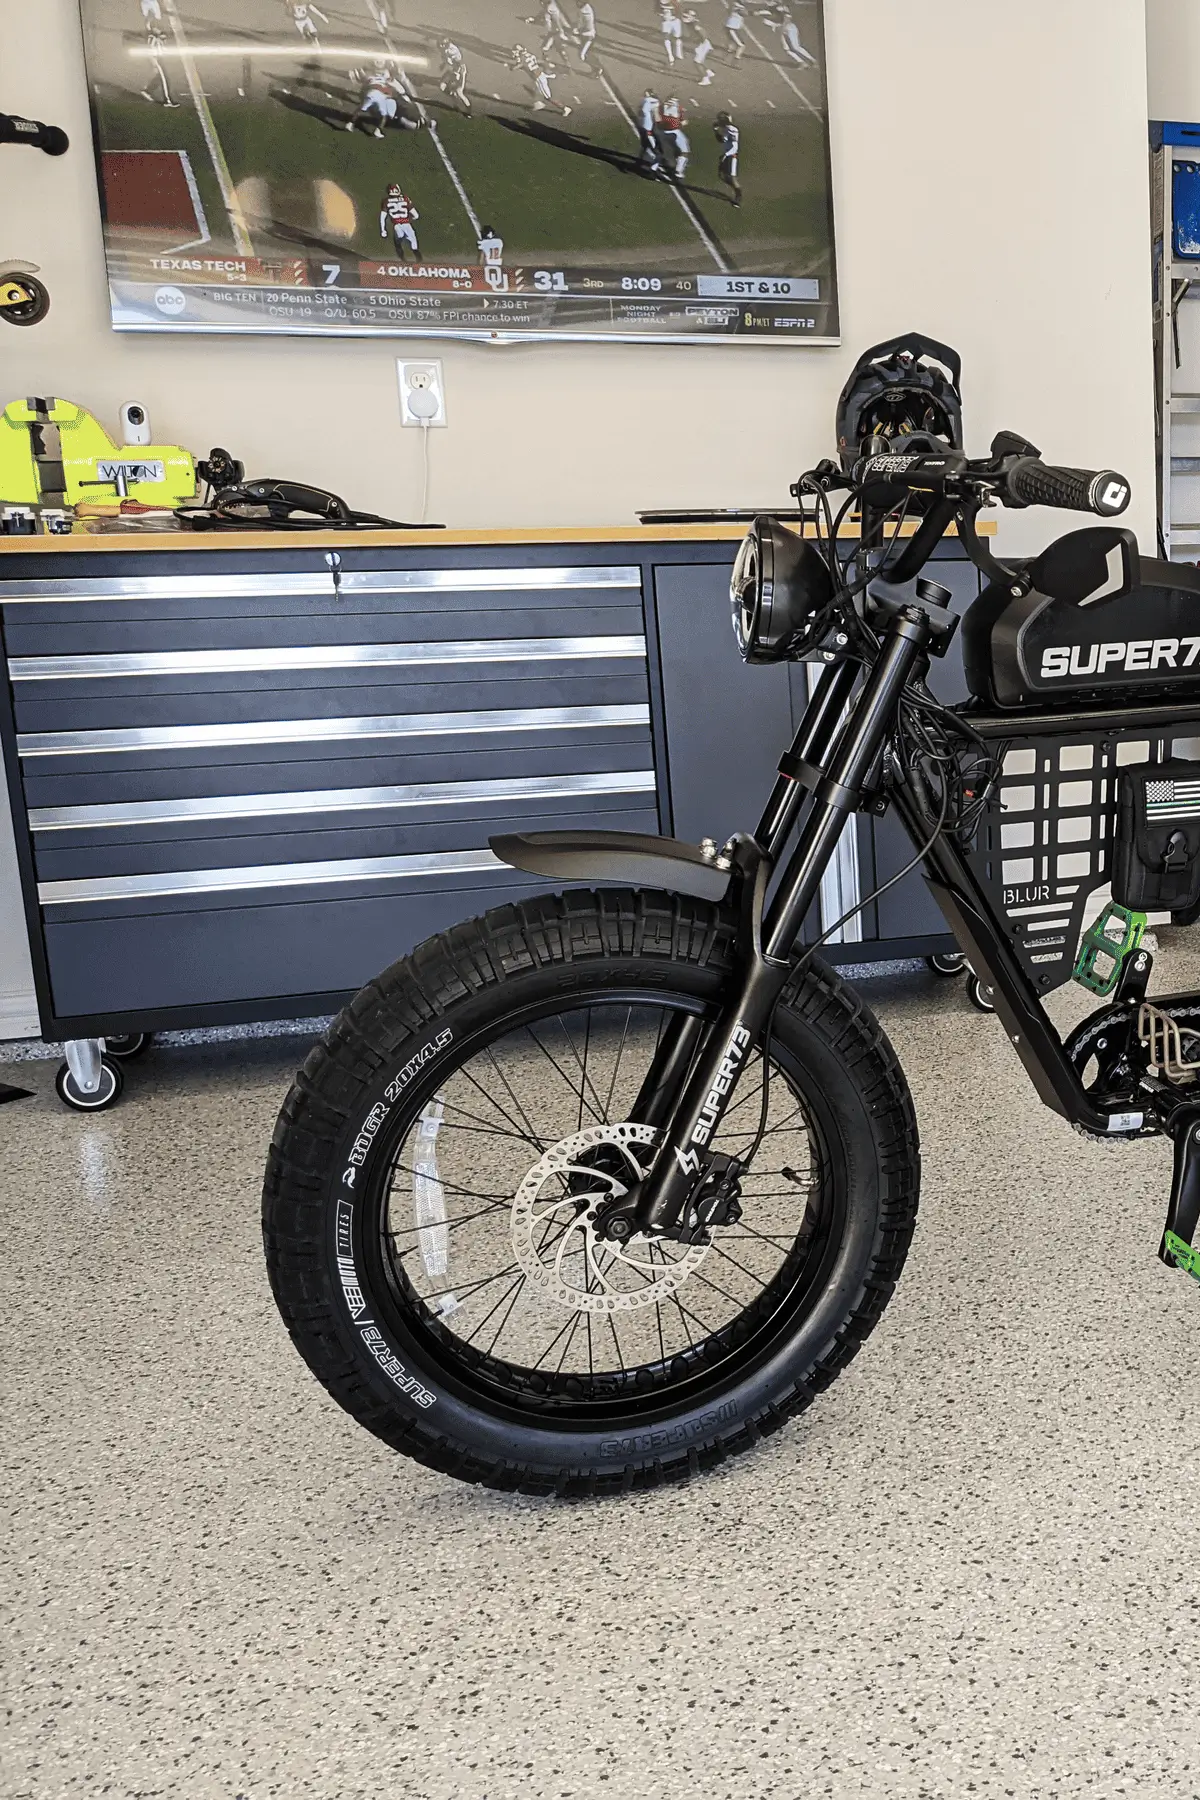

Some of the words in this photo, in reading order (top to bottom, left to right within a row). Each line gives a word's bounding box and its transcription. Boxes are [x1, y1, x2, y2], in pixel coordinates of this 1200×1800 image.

[387, 201, 408, 219] 25
[150, 259, 202, 271] TEXAS
[204, 260, 246, 272] TECH
[226, 273, 247, 282] 5-3
[322, 264, 341, 284] 7
[377, 266, 386, 275] 4
[388, 266, 471, 279] OKLAHOMA
[452, 280, 472, 289] 8-0
[533, 270, 569, 291] 31
[583, 277, 604, 288] 3RD
[621, 277, 662, 291] 8:09
[675, 281, 692, 290] 40
[726, 281, 755, 293] 1ST
[758, 282, 770, 293] &
[772, 282, 791, 294] 10
[213, 292, 233, 302] BIG
[235, 292, 257, 302] TEN
[266, 292, 279, 303] 20
[281, 293, 312, 304] Penn
[314, 293, 348, 305] State
[369, 295, 377, 305] 5
[378, 295, 407, 306] Ohio
[409, 296, 441, 308] State
[269, 306, 293, 317] OSU
[516, 301, 529, 310] ET
[620, 304, 662, 312] MONDAY
[443, 312, 460, 322] FPI
[461, 313, 498, 323] chance
[500, 313, 510, 323] to
[512, 314, 530, 324] win
[102, 465, 157, 478] WILTON
[1003, 885, 1050, 905] BLUR
[384, 1027, 454, 1103] 20X4.5
[691, 1026, 751, 1145] SUPER73
[339, 1213, 350, 1248] TIRES
[360, 1326, 437, 1409] SUPER73
